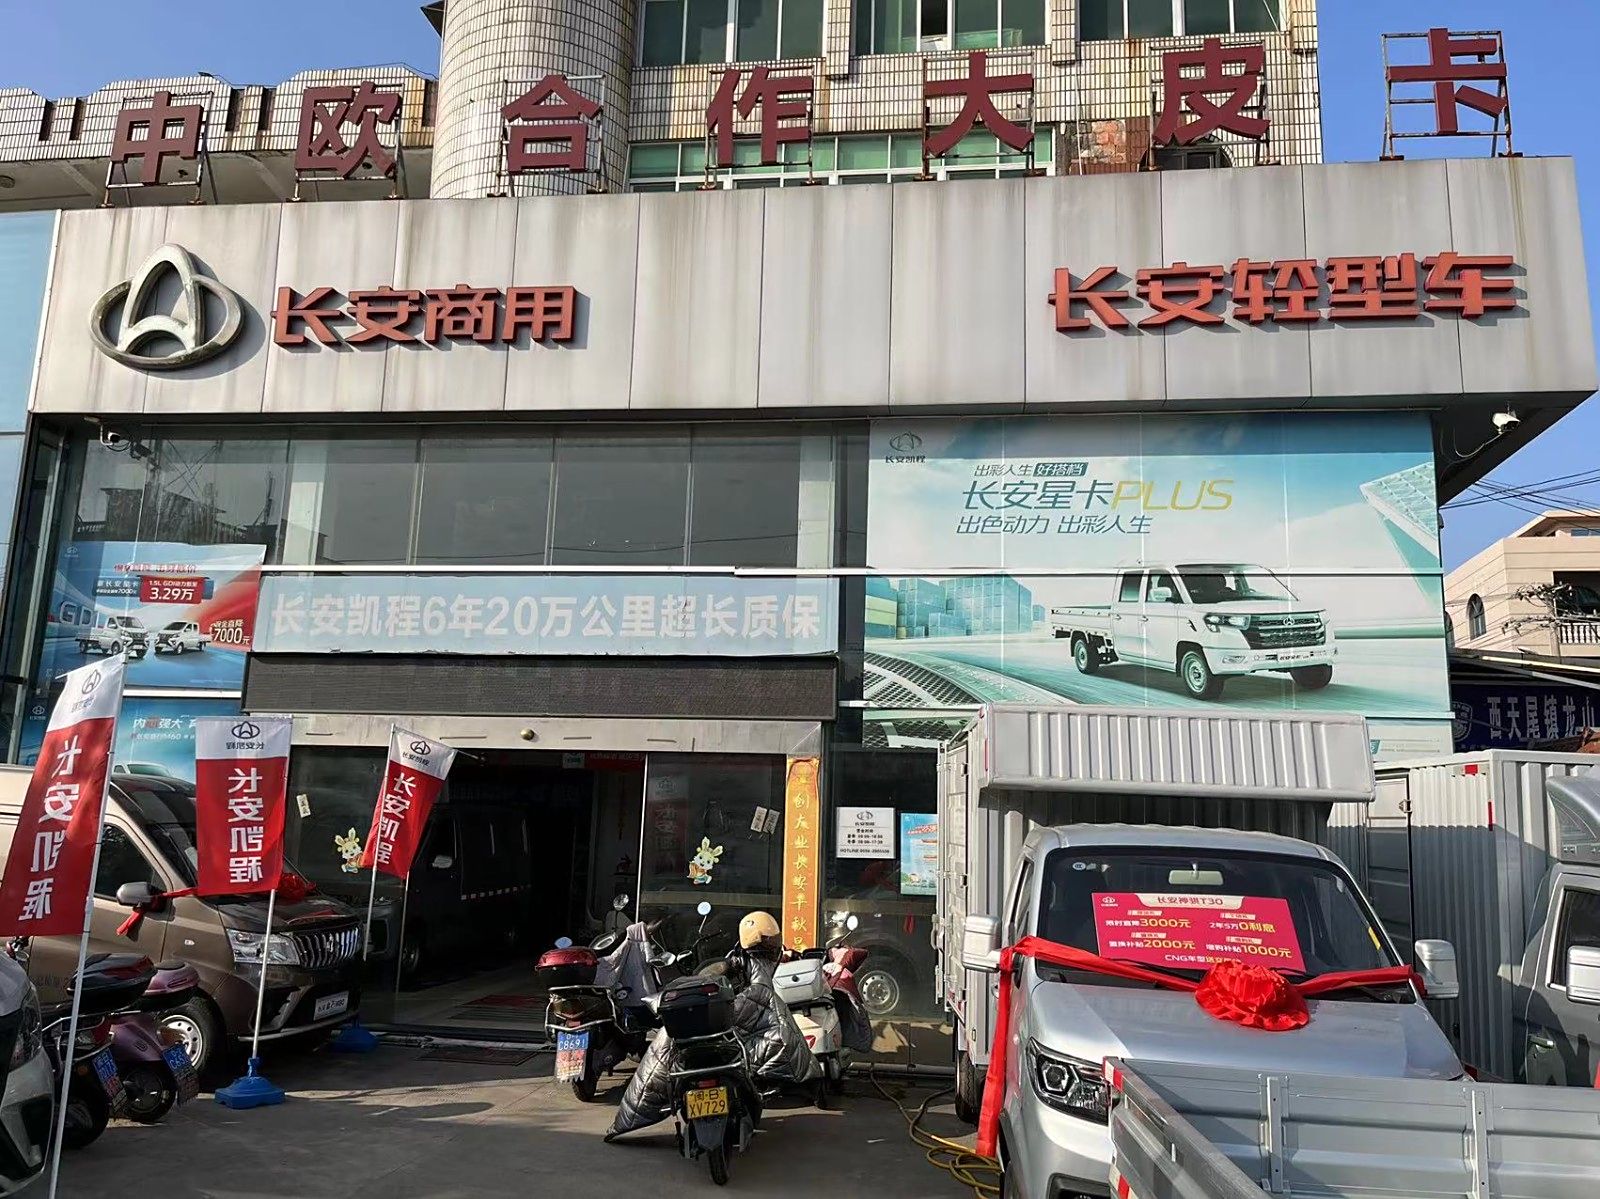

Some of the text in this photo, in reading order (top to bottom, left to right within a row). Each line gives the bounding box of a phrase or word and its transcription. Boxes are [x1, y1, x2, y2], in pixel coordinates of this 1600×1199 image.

[110, 27, 1508, 187] 中欧合作大皮卡
[1048, 251, 1518, 333] 长安轻型车
[271, 284, 577, 348] 长安商用
[974, 463, 1087, 477] 出彩人生 好搭档
[962, 479, 1235, 511] 长安星卡PLUS
[956, 515, 1153, 534] 出色动力 出彩人生
[149, 587, 195, 601] 3.29万
[271, 593, 822, 641] 长安凯程6年20万公里超长质保
[689, 1099, 726, 1118] XV729
